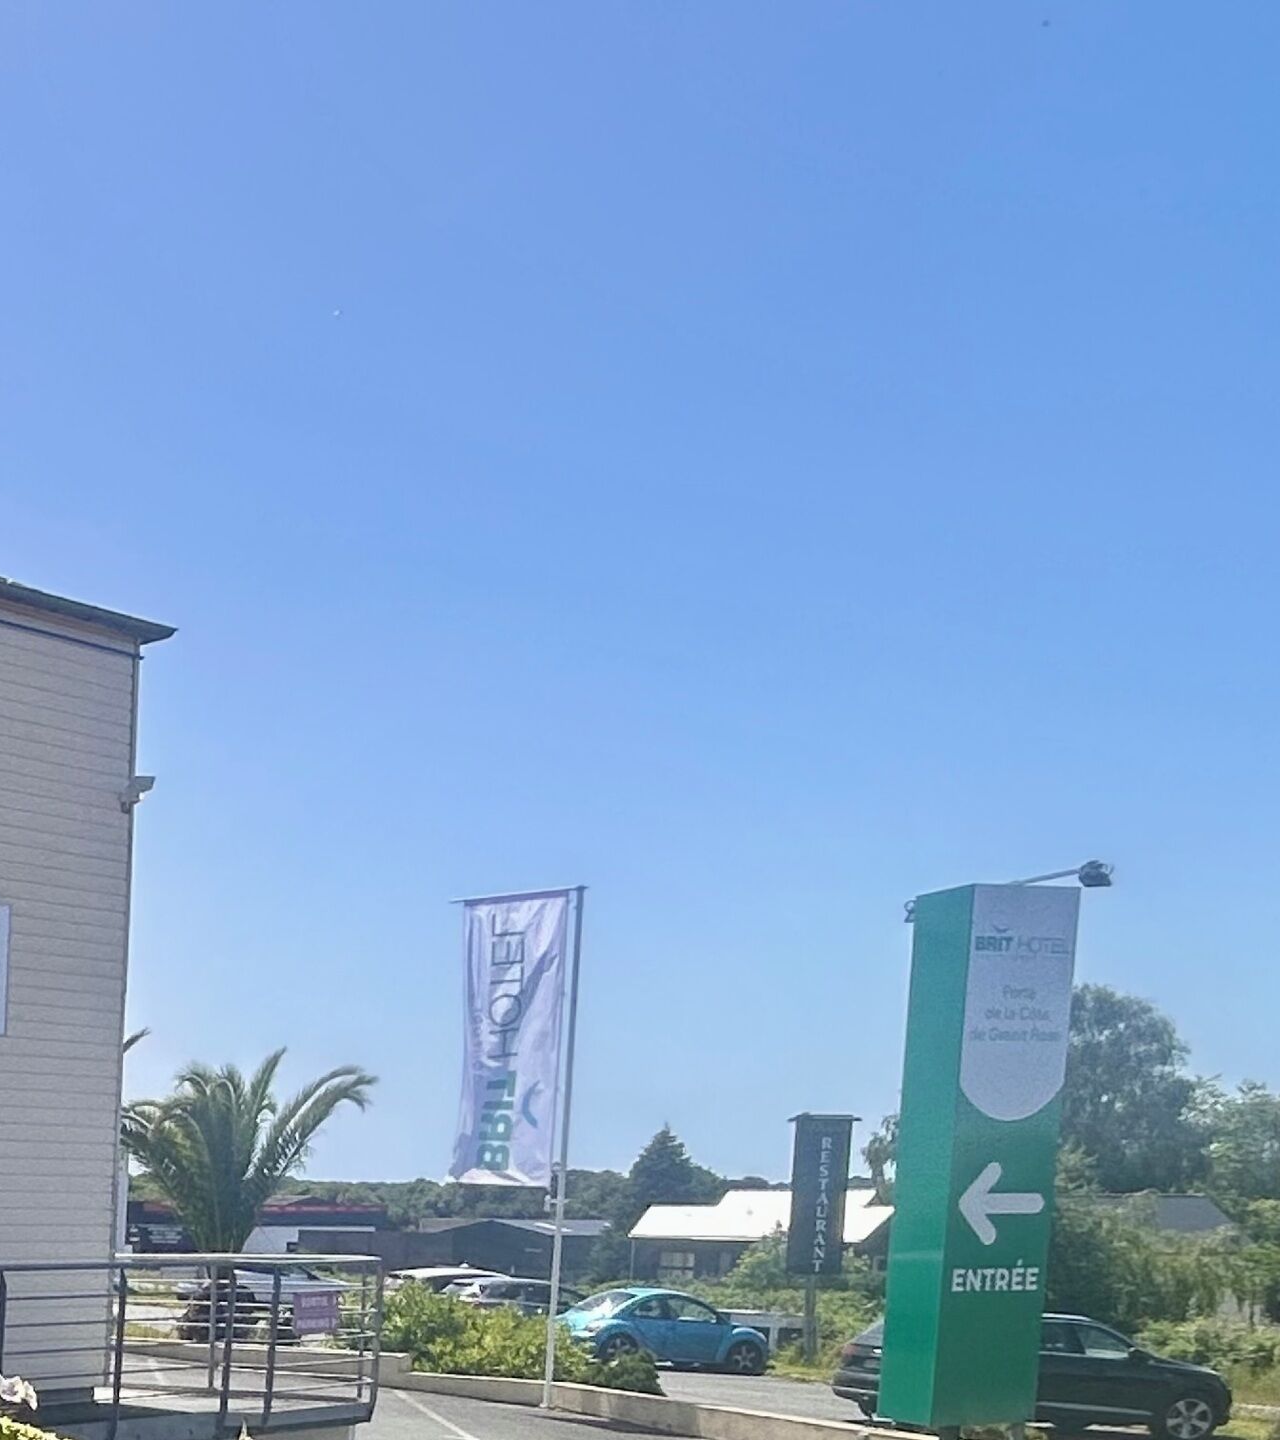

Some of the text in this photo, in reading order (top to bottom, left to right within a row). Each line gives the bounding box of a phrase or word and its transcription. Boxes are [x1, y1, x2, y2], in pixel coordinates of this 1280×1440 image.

[975, 935, 1071, 956] BRIT HOTEL
[812, 1136, 833, 1274] RESTAURANT
[951, 1258, 1040, 1292] ENTRÉE
